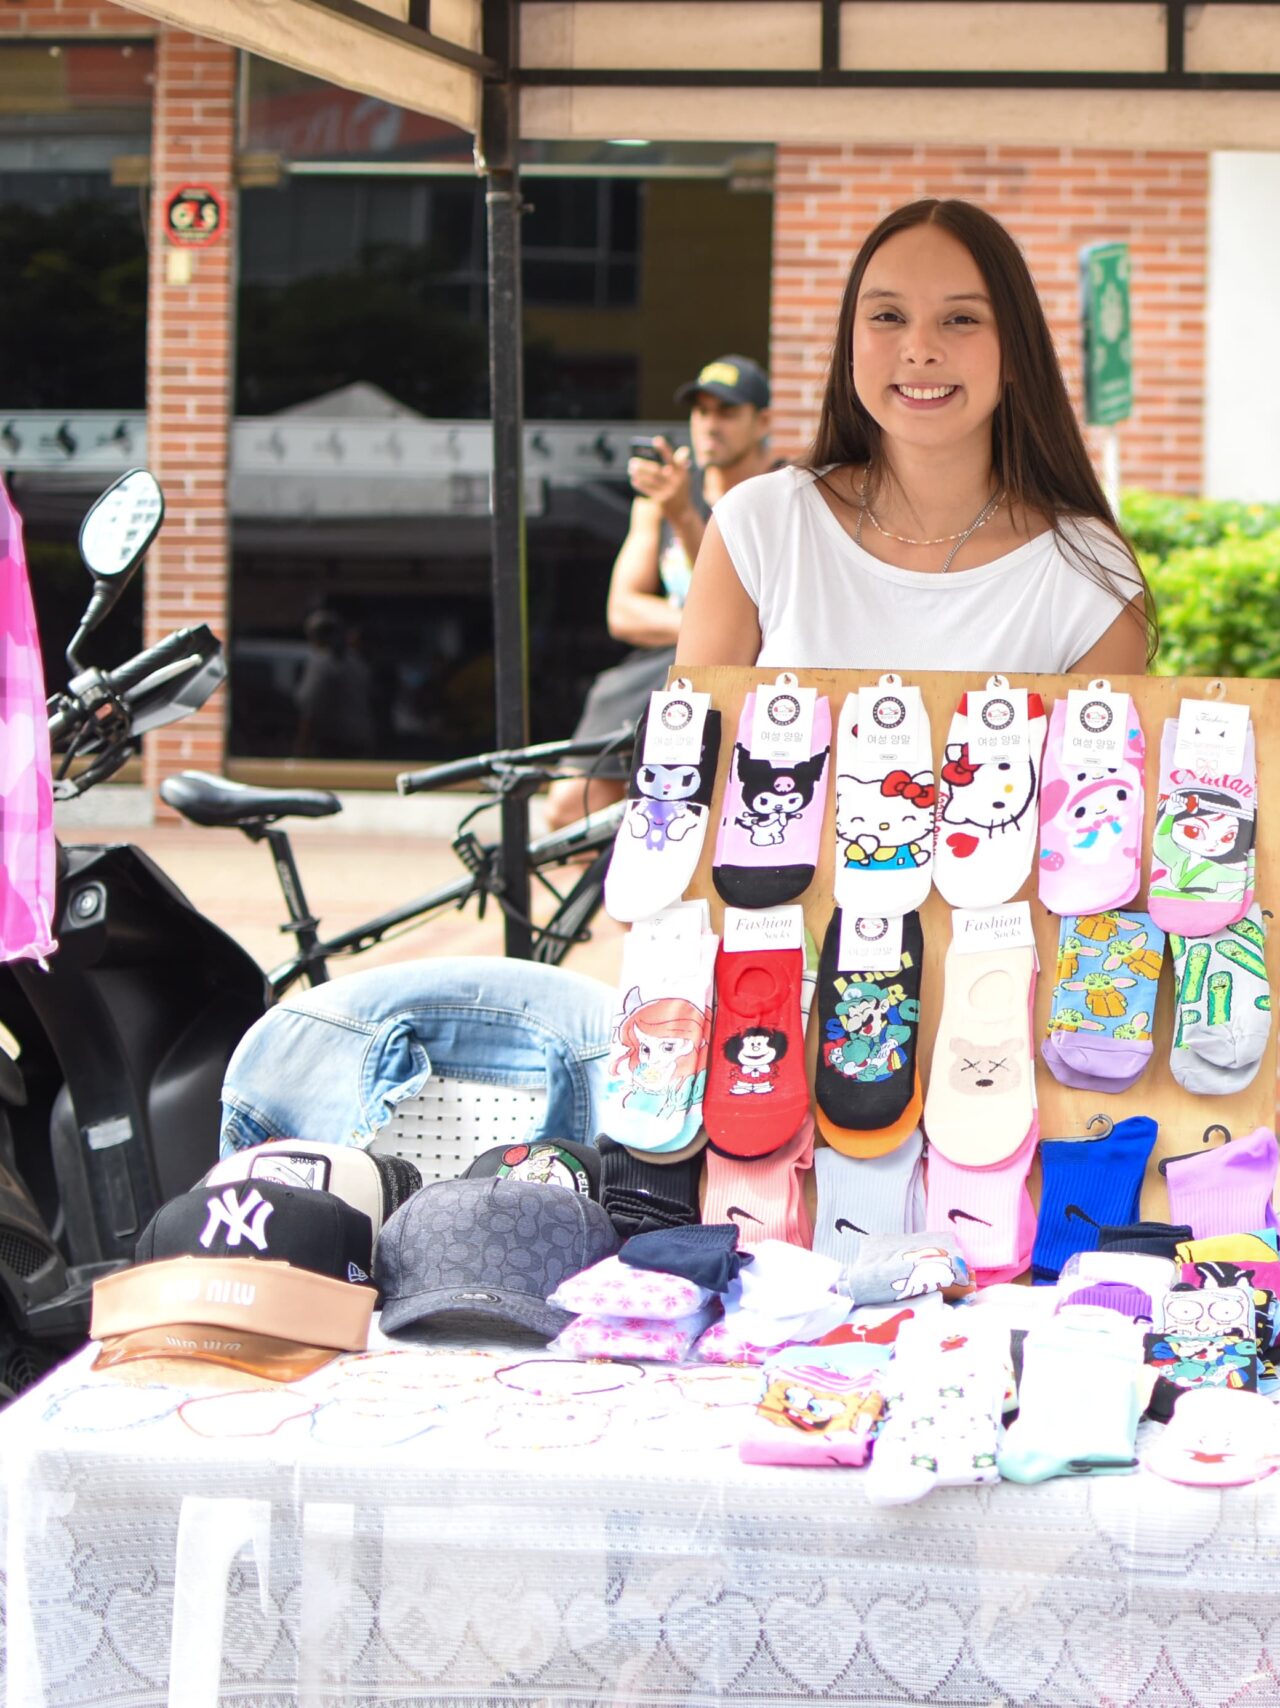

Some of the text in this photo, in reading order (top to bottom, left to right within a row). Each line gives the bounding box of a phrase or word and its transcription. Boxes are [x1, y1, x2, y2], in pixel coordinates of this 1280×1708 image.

[736, 916, 793, 931] Fashion
[964, 915, 1022, 932] Fashion
[764, 930, 790, 940] Socks
[199, 1187, 275, 1251] NY
